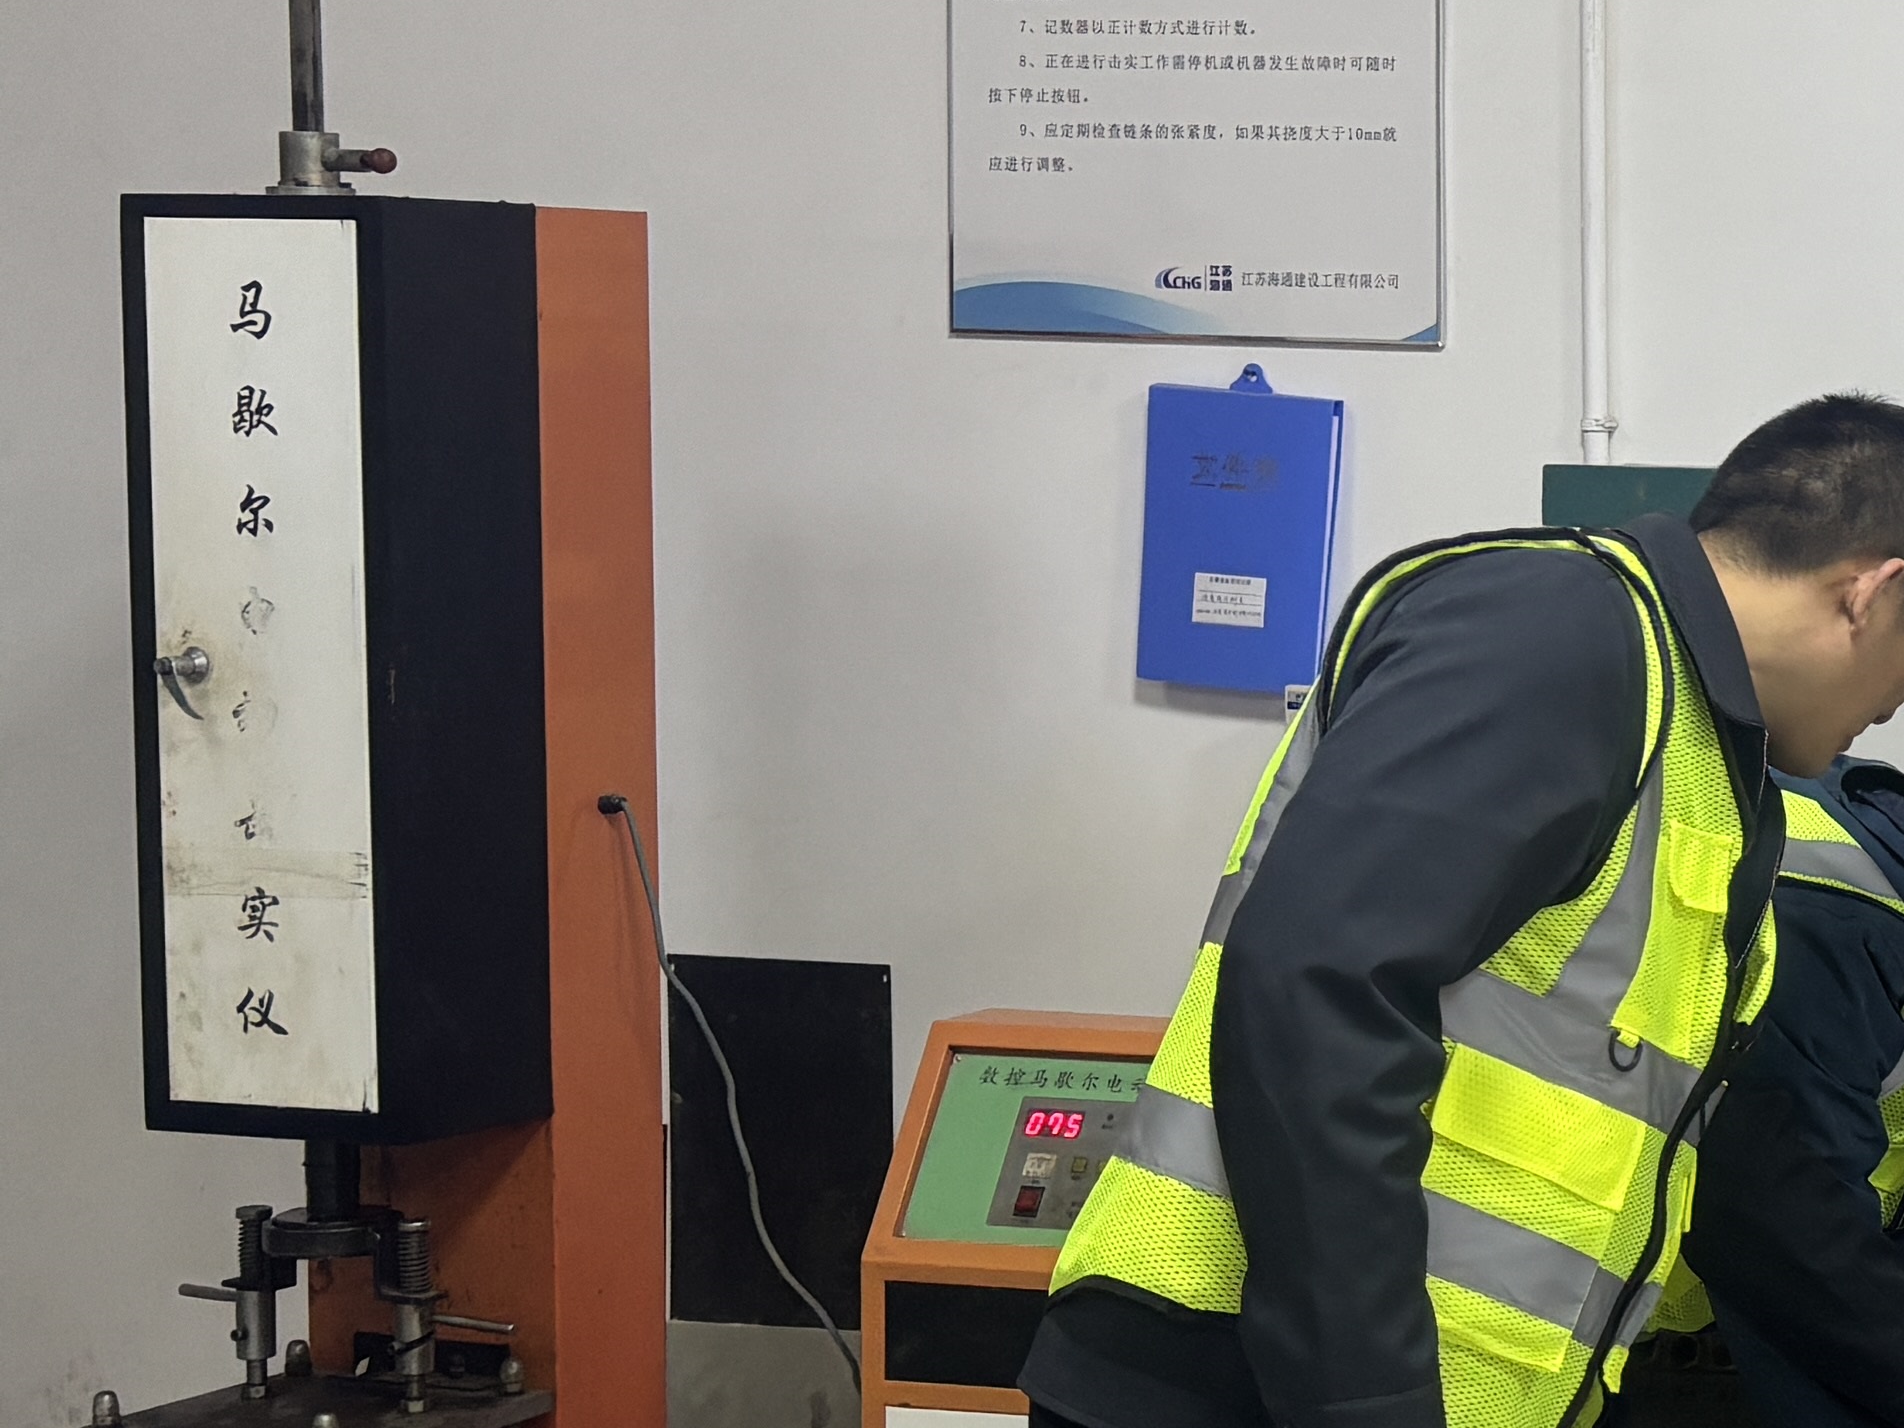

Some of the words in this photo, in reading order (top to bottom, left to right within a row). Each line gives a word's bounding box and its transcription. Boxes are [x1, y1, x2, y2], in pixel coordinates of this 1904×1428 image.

[988, 87, 1089, 105] 按下停止按钮。
[989, 155, 1074, 173] 应进行调整。
[1240, 271, 1400, 290] 江苏海通建设工程有限公司
[228, 278, 290, 1040] 马歇尔实仪
[1025, 1111, 1083, 1139] 075
